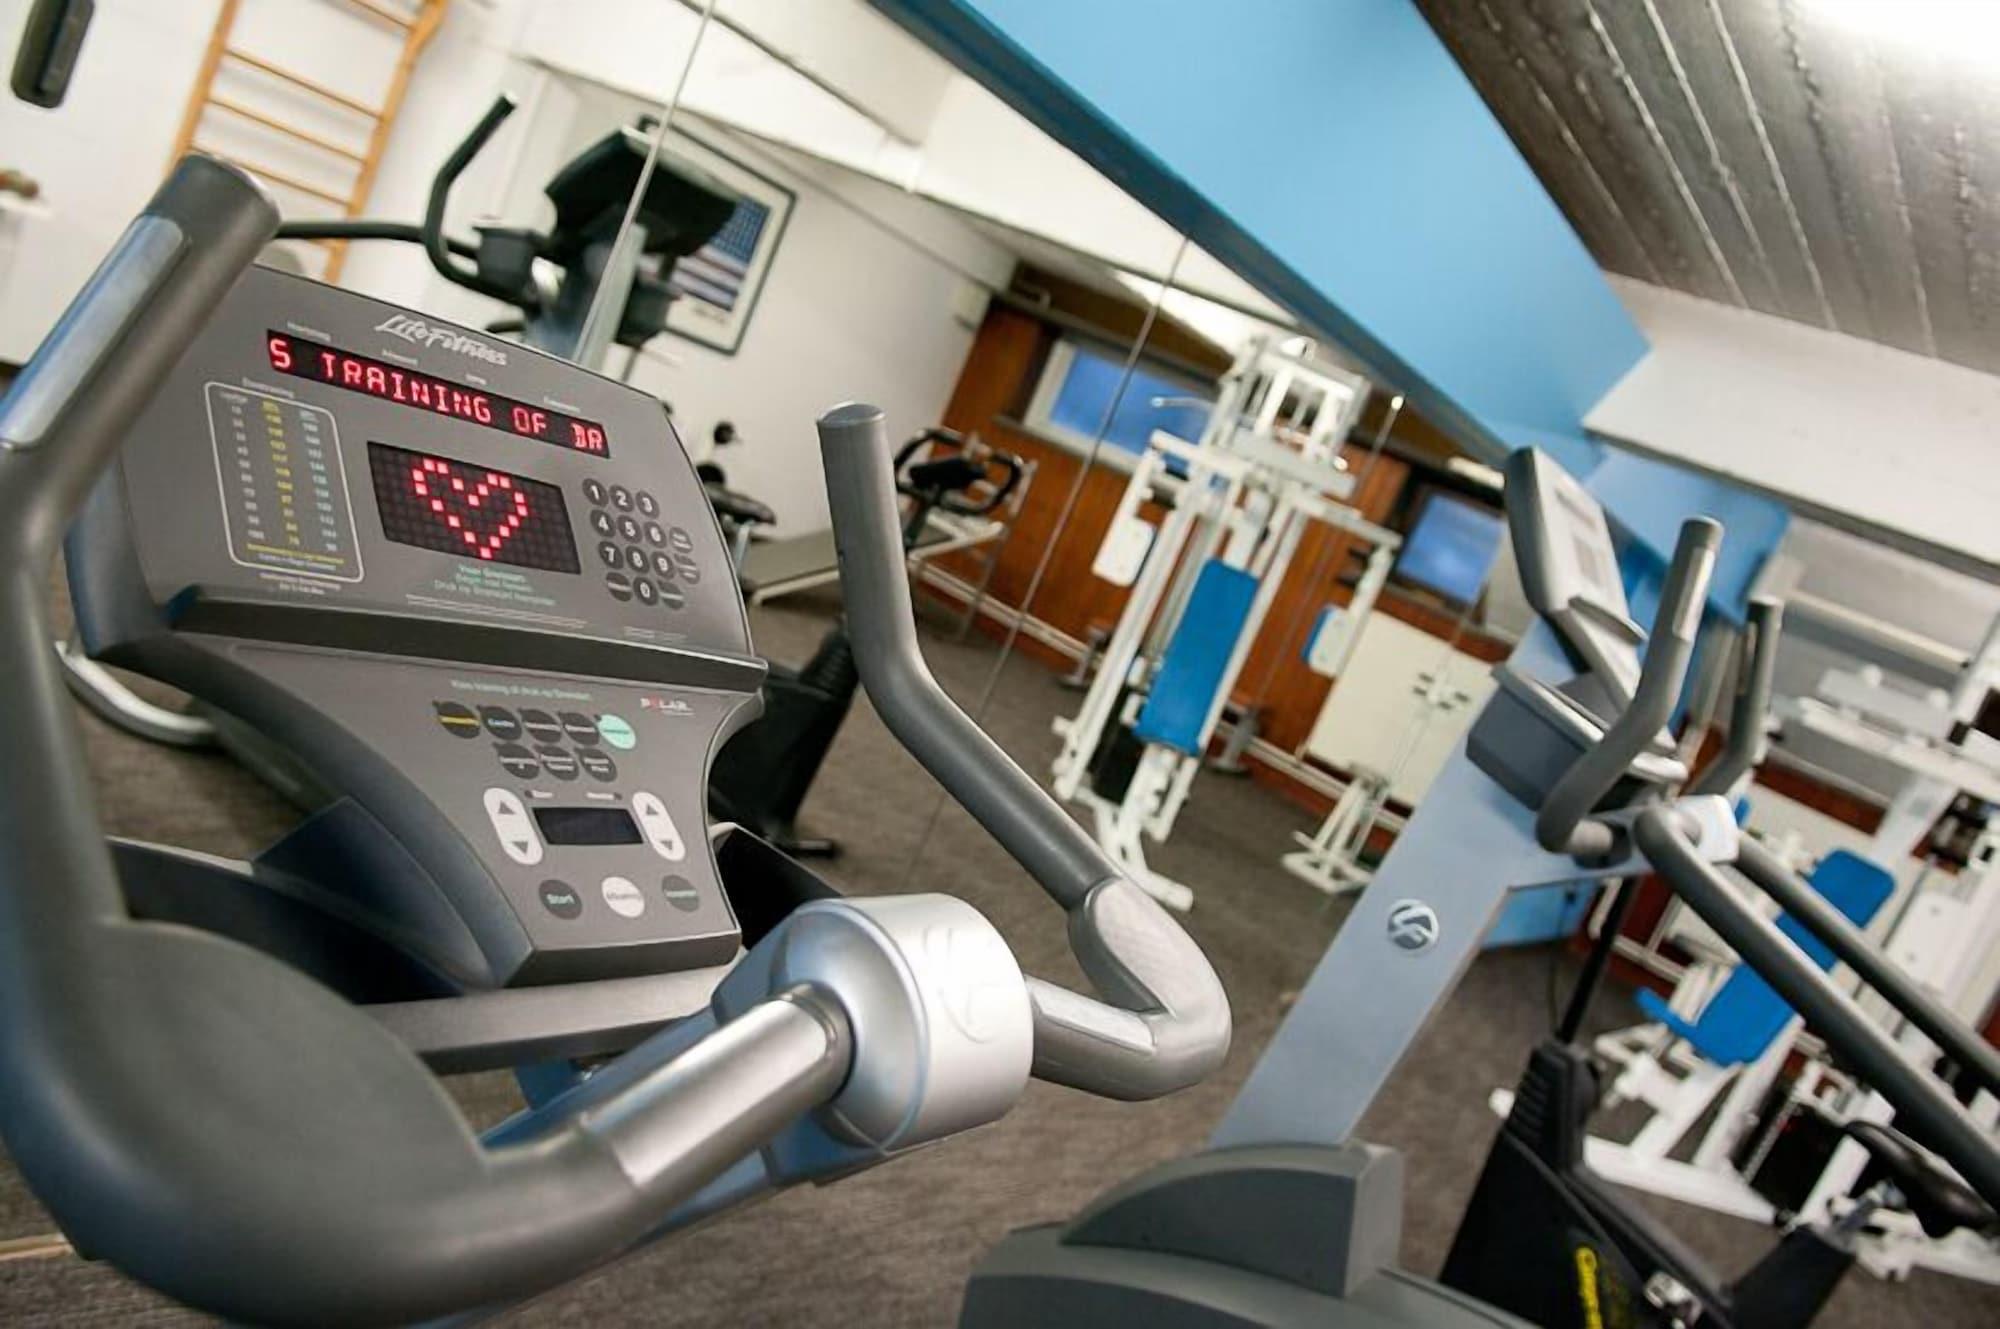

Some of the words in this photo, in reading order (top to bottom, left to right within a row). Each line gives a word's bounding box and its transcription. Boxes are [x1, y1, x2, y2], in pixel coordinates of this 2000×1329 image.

[269, 338, 291, 369] S
[321, 352, 491, 424] TRAINING
[513, 406, 547, 434] OF
